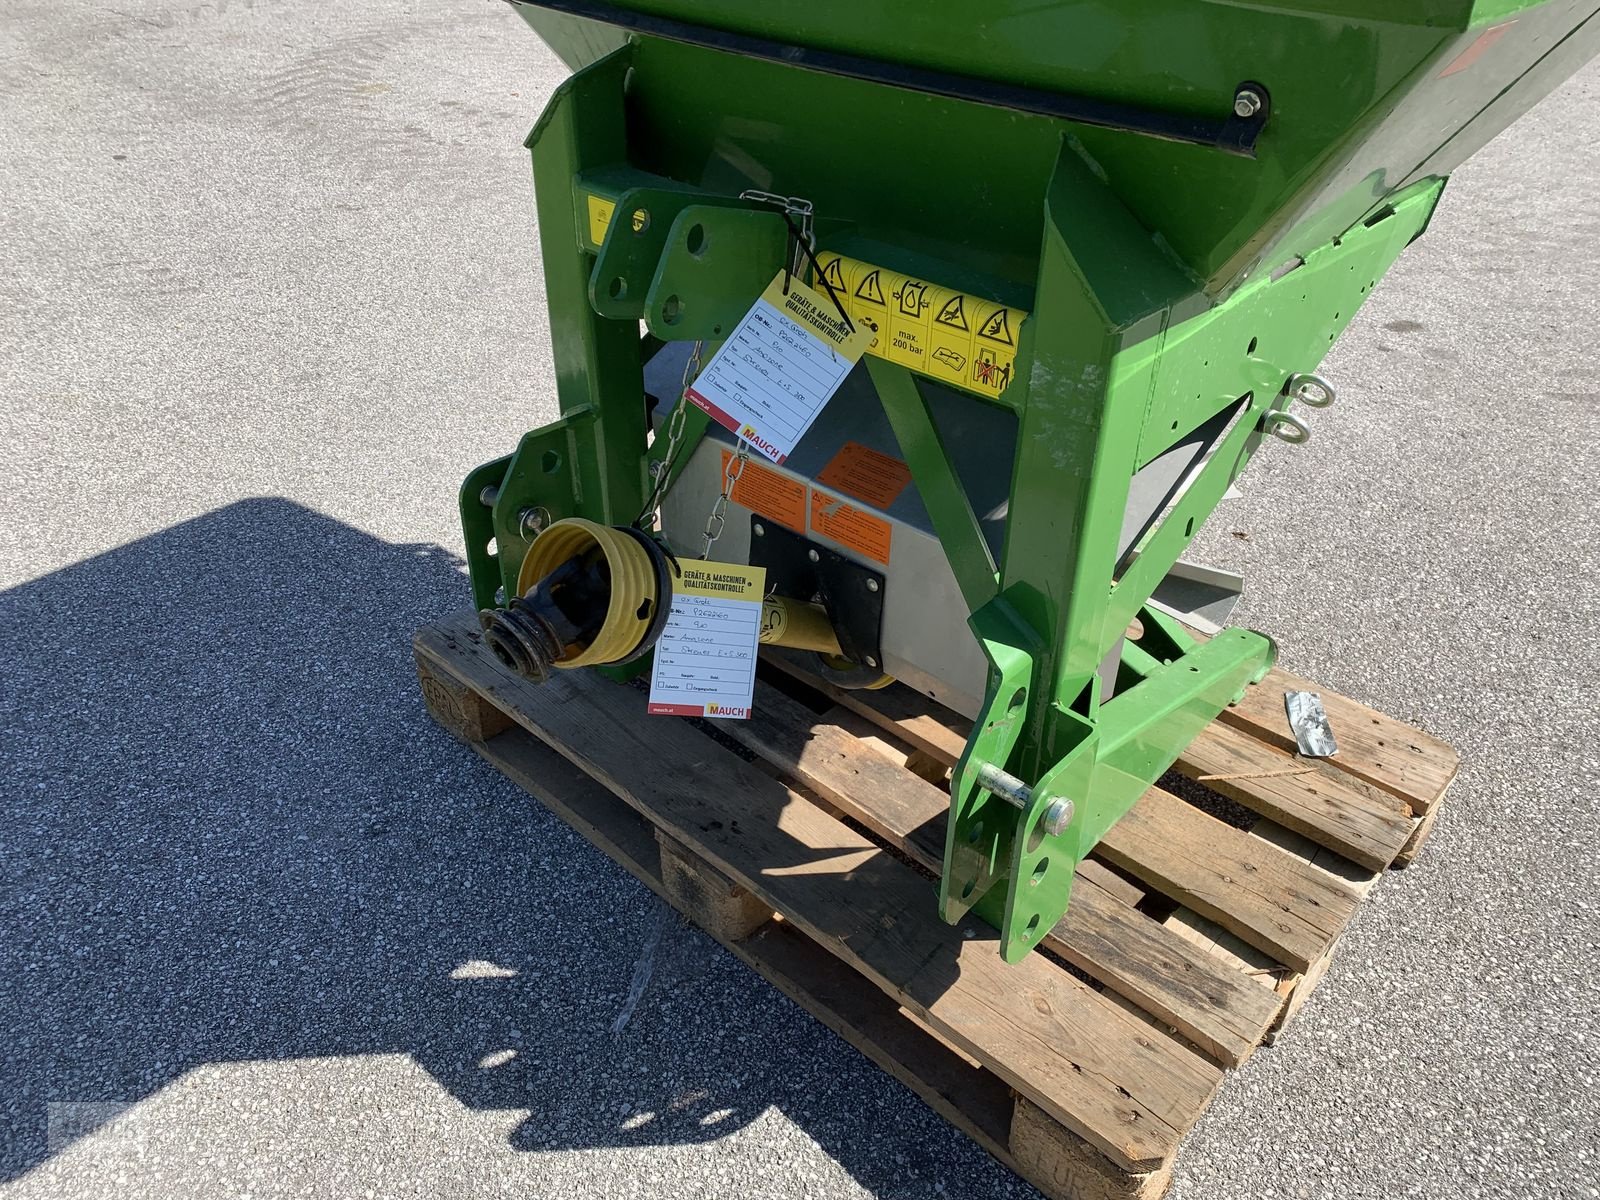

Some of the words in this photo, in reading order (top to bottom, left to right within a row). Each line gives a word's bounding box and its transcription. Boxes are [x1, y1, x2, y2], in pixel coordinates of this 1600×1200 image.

[785, 300, 845, 344] QUALITÄTSKONTROLLE
[790, 291, 813, 310] GERÄTE
[809, 305, 817, 314] &
[816, 310, 851, 337] MASCHINEN
[898, 331, 918, 342] max.
[892, 338, 908, 349] 200
[909, 343, 924, 355] bar
[743, 429, 780, 458] MAUCH
[683, 569, 704, 579] GERÄTE
[712, 574, 746, 584] MASCHINEN
[683, 578, 744, 593] QUALITÄTSKONTROLLE
[709, 705, 744, 717] MAUCH
